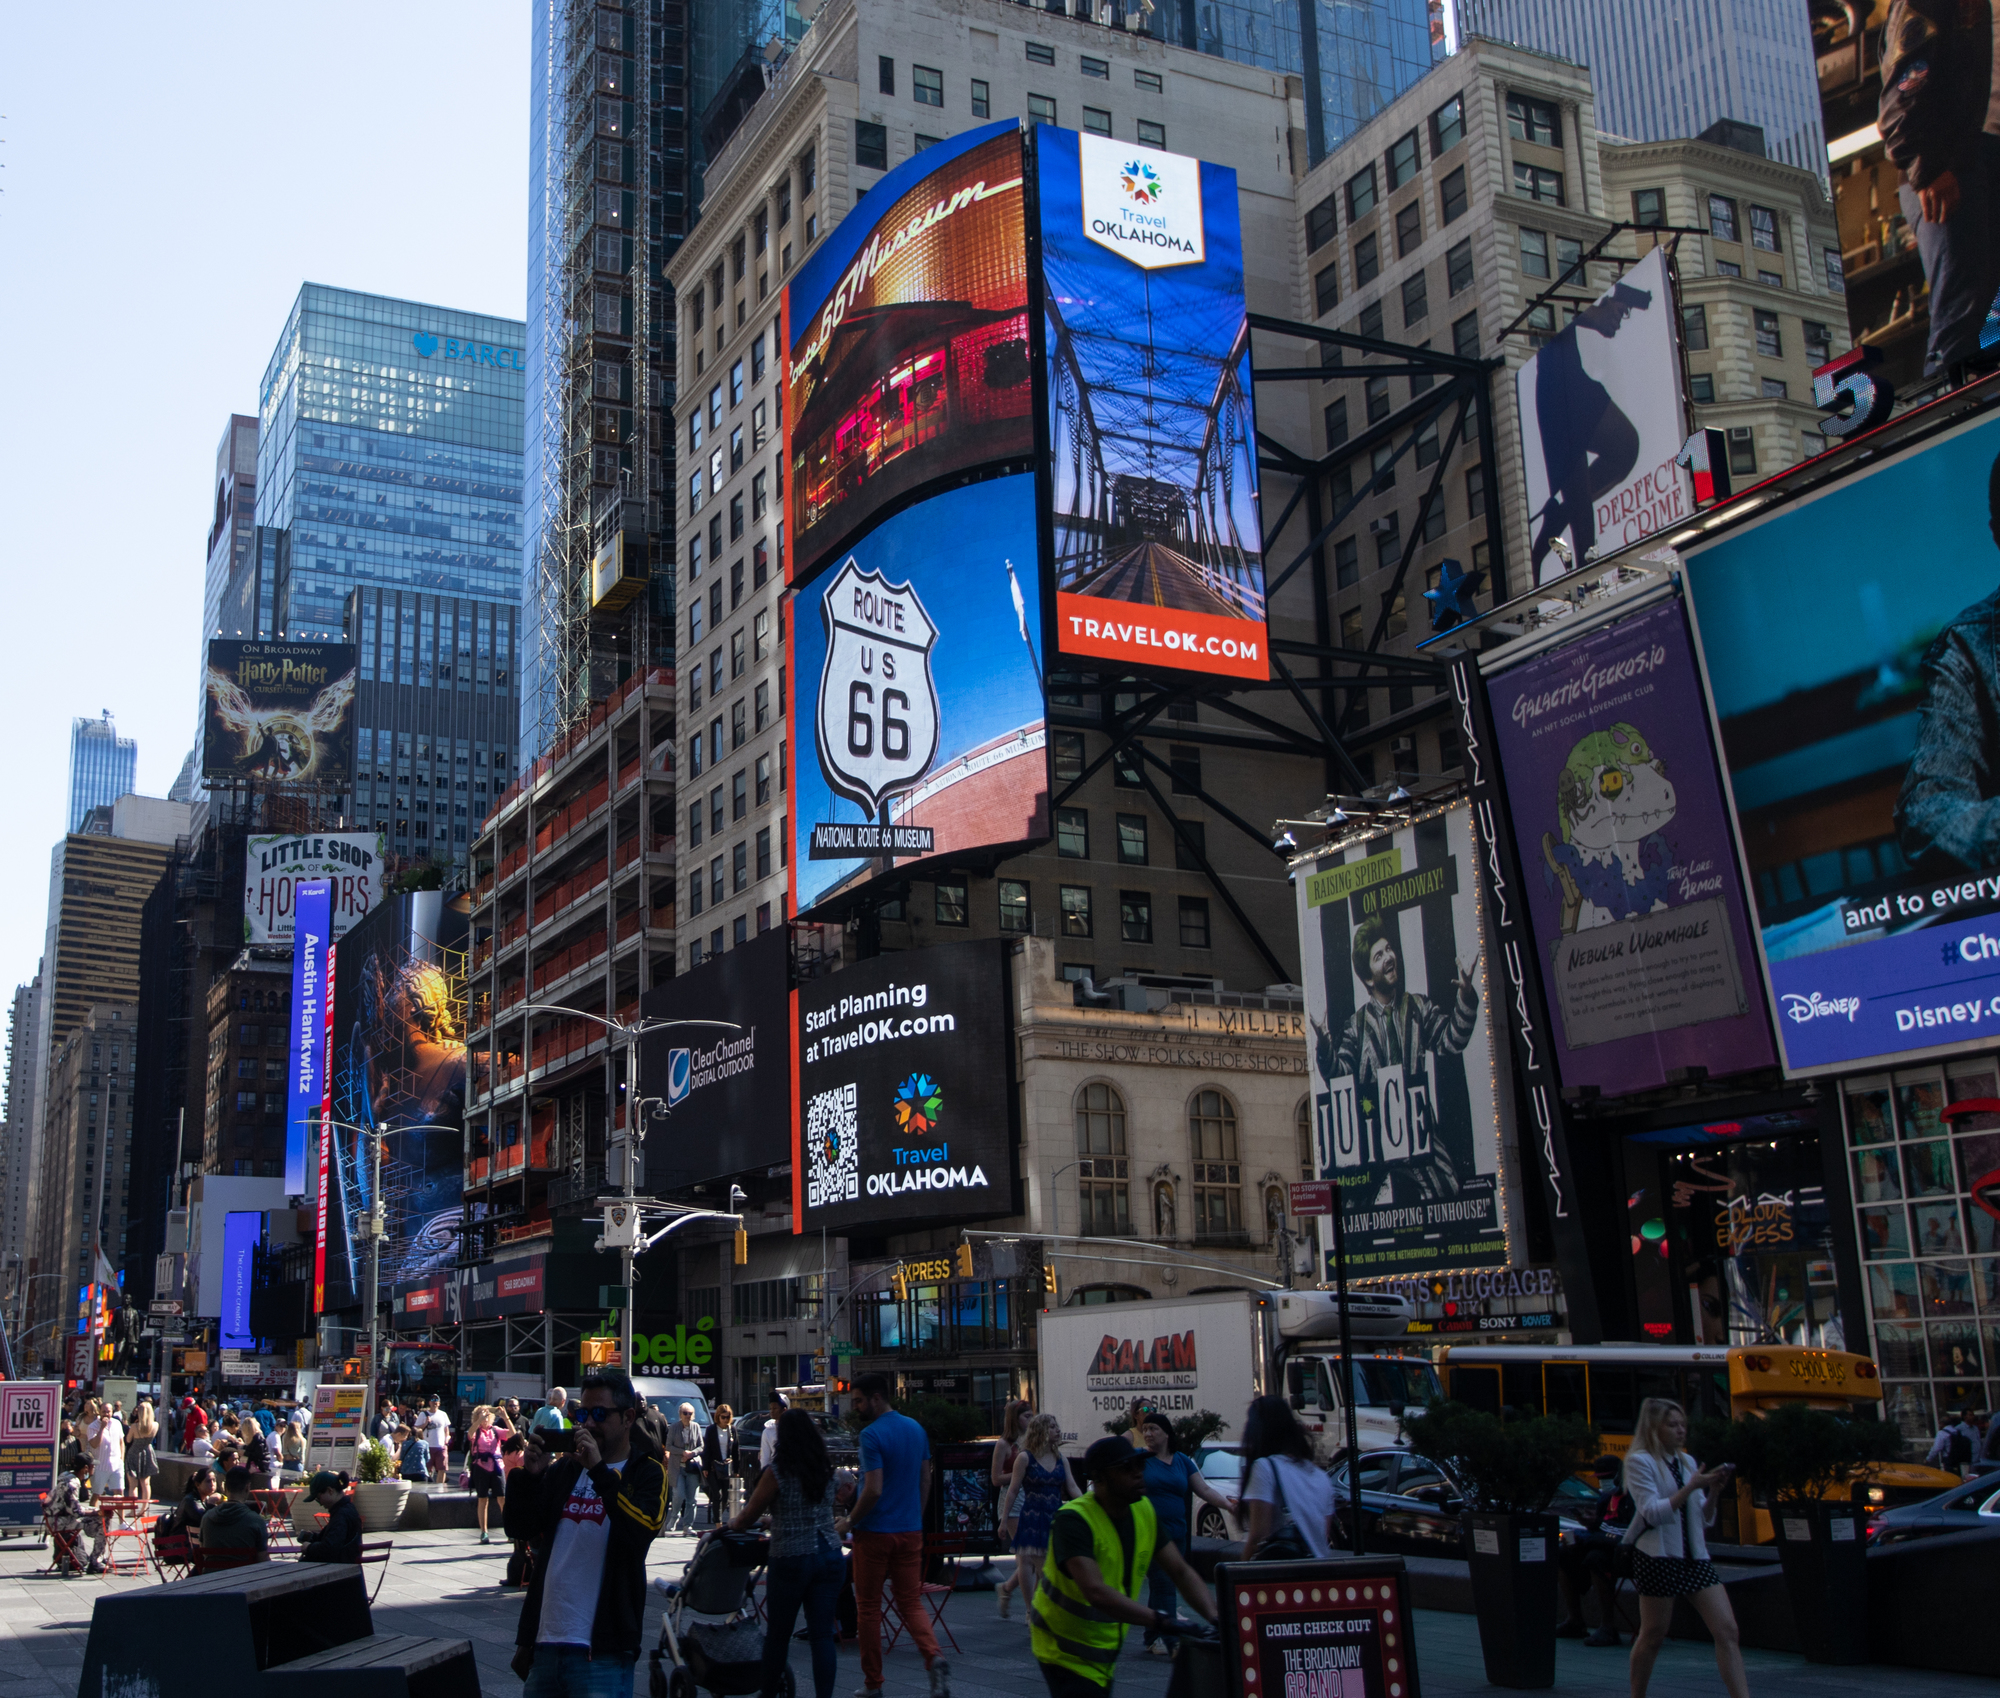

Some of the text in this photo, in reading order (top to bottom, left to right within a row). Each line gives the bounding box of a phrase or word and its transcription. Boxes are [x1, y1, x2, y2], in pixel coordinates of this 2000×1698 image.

[1119, 207, 1167, 230] Travel
[849, 177, 1023, 307] Museum
[1092, 219, 1196, 255] OKLAHOMA
[445, 338, 526, 370] BARCL
[1597, 455, 1679, 535] PERFECT
[1623, 486, 1684, 545] CRIME
[854, 586, 906, 633] ROUTE
[1069, 616, 1258, 661] TRAVELOK.COM
[235, 659, 328, 689] Harry Potter
[1571, 653, 1590, 666] VISIT
[253, 685, 283, 694] CURSED
[284, 686, 309, 695] CHILD
[848, 680, 911, 761] 66
[1532, 683, 1655, 738] AN NFT SOCIAL ADVENTURE CLUB
[815, 826, 931, 849] NATIONAL ROUTE 66 MUSEUM
[261, 839, 373, 873] LITTLE SHOP
[307, 864, 321, 872] OF
[1313, 856, 1393, 901] RAISING SPIRITS
[1362, 867, 1444, 914] ON BROADWAY!
[1679, 875, 1723, 900] ARMOR
[1845, 897, 1892, 929] and
[1896, 894, 1925, 916] to
[1567, 920, 1710, 972] NEBULAR WORMHOLE
[1940, 933, 2000, 966] #Ch
[303, 932, 319, 997] Austin
[1578, 978, 1599, 989] geckos
[1601, 974, 1613, 982] who
[1626, 966, 1644, 976] brave
[1646, 959, 1670, 973] enough
[1671, 957, 1678, 965] to
[1679, 956, 1689, 967] try
[1648, 975, 1664, 984] close
[1665, 969, 1689, 982] enough
[1690, 977, 1725, 992] displaying
[805, 983, 927, 1033] Start Planning
[1218, 1010, 1305, 1035] MILLER
[299, 999, 317, 1094] Hankwitz
[806, 1014, 955, 1063] at TravelOK.com
[1059, 1041, 1090, 1058] THE
[1095, 1044, 1139, 1062] SHOW
[1149, 1047, 1196, 1065] FOLKS
[1202, 1051, 1244, 1069] SHOE
[1249, 1054, 1288, 1072] SHOP
[691, 1053, 754, 1090] DIGITAL OUTDOOR
[320, 1111, 330, 1169] COME
[892, 1143, 948, 1166] Travel
[866, 1165, 989, 1197] OKLAHOMA
[1291, 1184, 1330, 1193] NO STOPPING
[317, 1174, 328, 1249] INSIDE!
[1292, 1193, 1316, 1201] Anytime
[1348, 1206, 1423, 1234] JAW-DROPPING
[1714, 1204, 1792, 1227] COLOUR
[237, 1249, 245, 1265] The
[1352, 1240, 1505, 1265] THIS WAY TO THE NETHERWORLD 50TH & BROADWAY
[1447, 1268, 1554, 1300] LUGGAGE
[1407, 1314, 1552, 1333] Nikon Canon SONY BOWER
[1098, 1330, 1196, 1372] SALEM
[270, 1369, 289, 1377] Sale
[641, 1365, 700, 1375] SOCCER
[933, 1379, 956, 1388] EXPRESS
[1090, 1374, 1194, 1386] TRUCK LEASING, INC.
[1789, 1359, 1846, 1380] SCHOOL BUS
[17, 1398, 40, 1411] TSQ
[11, 1411, 44, 1429] LIVE
[21, 1455, 34, 1463] AND
[1265, 1619, 1371, 1637] COME CHECK OUT
[1282, 1645, 1361, 1672] THE BROADWAY
[1284, 1669, 1342, 1698] GRAND
